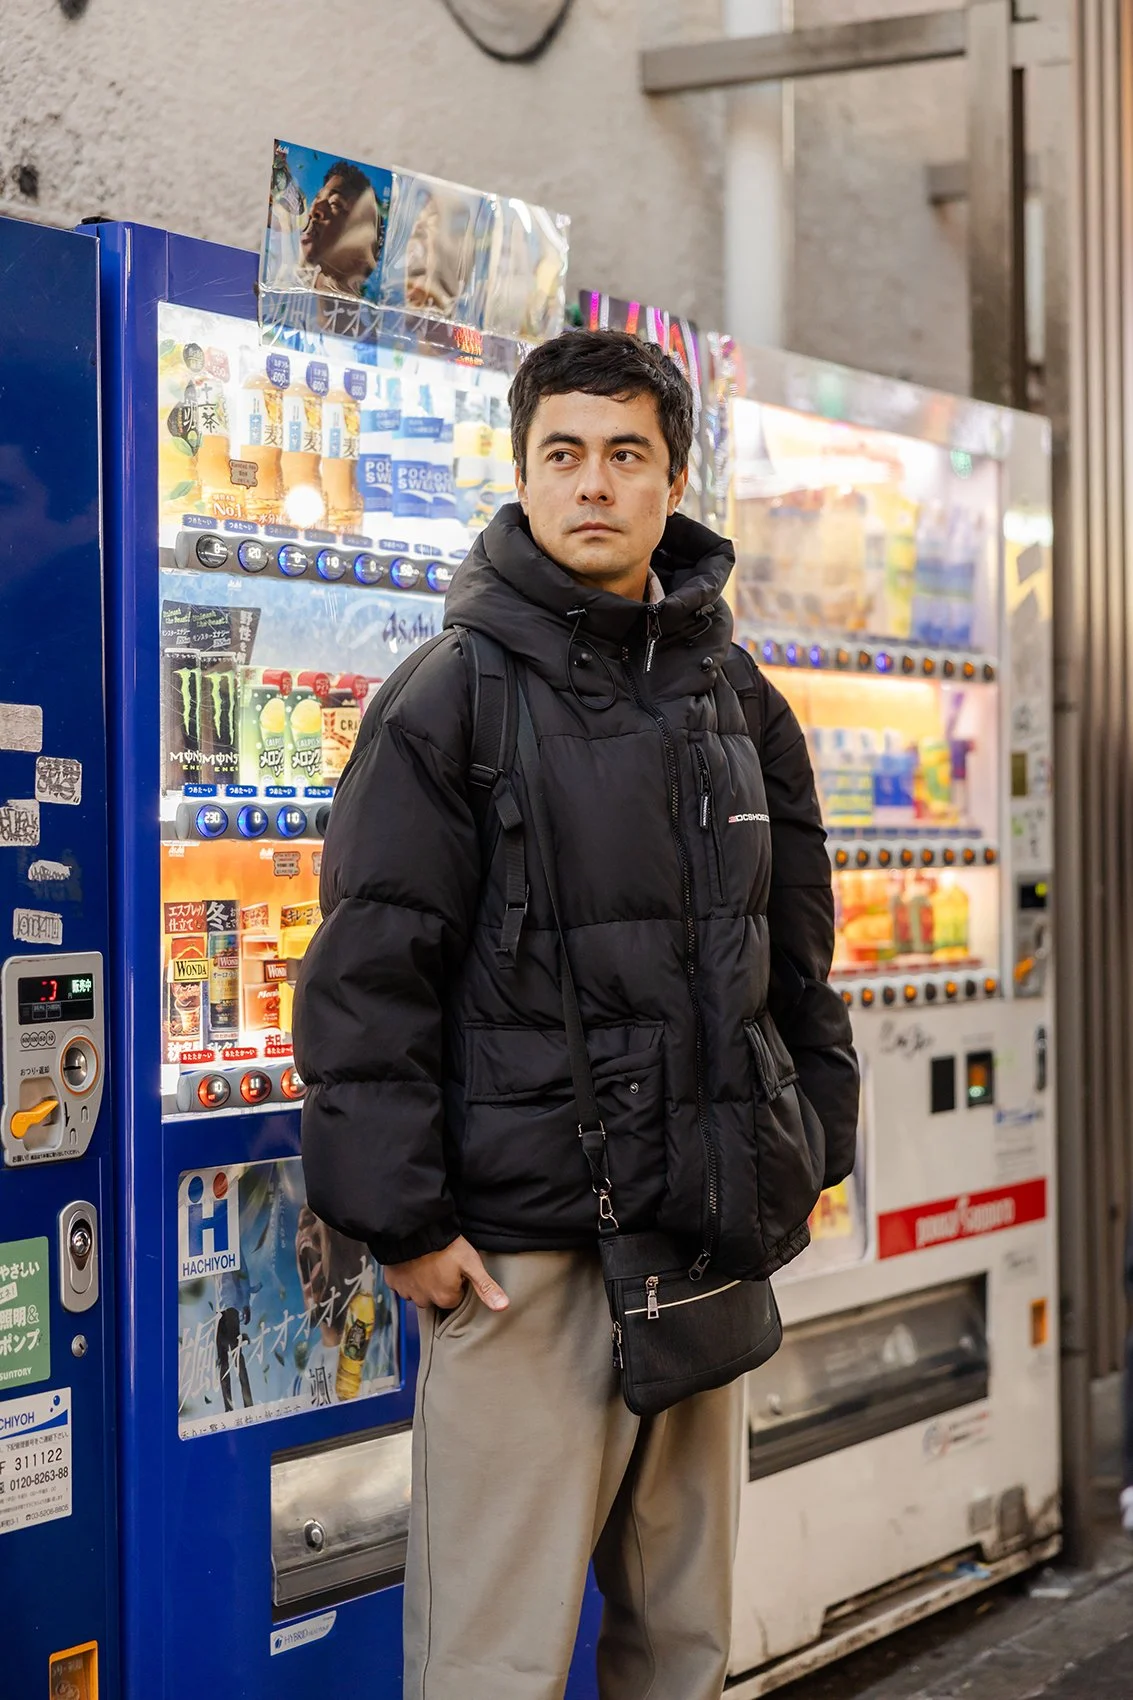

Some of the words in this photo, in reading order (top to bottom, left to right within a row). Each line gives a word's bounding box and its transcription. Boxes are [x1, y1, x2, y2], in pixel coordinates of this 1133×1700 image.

[213, 502, 242, 518] No.1
[168, 918, 194, 932] 仕立て
[176, 960, 207, 977] WONDA
[182, 1253, 236, 1277] HACHIYOH
[14, 1447, 63, 1471] 311122
[9, 1466, 69, 1492] 0120-8263-88
